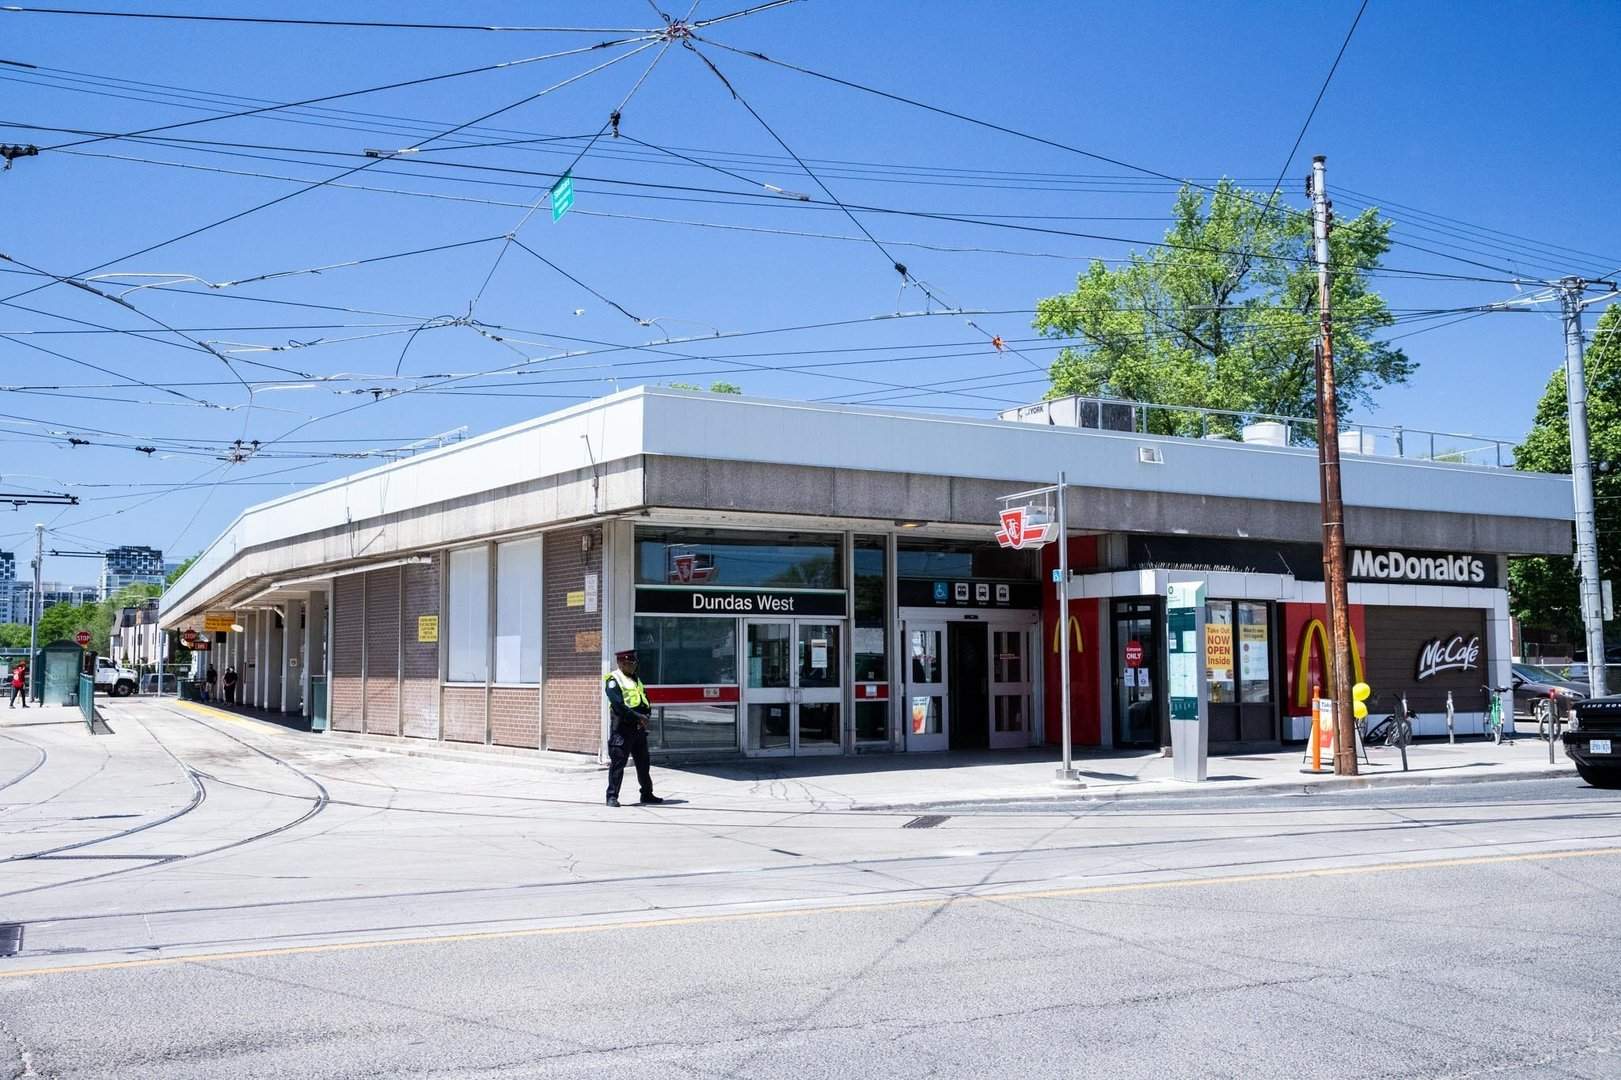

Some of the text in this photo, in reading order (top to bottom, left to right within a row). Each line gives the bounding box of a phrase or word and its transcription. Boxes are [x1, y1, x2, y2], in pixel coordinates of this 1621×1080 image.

[1030, 405, 1044, 415] YORK
[1351, 549, 1485, 582] McDonald's
[692, 593, 794, 611] Dundas West
[1207, 635, 1231, 645] NOW
[1207, 646, 1231, 655] OPEN
[1419, 635, 1480, 675] McCafé
